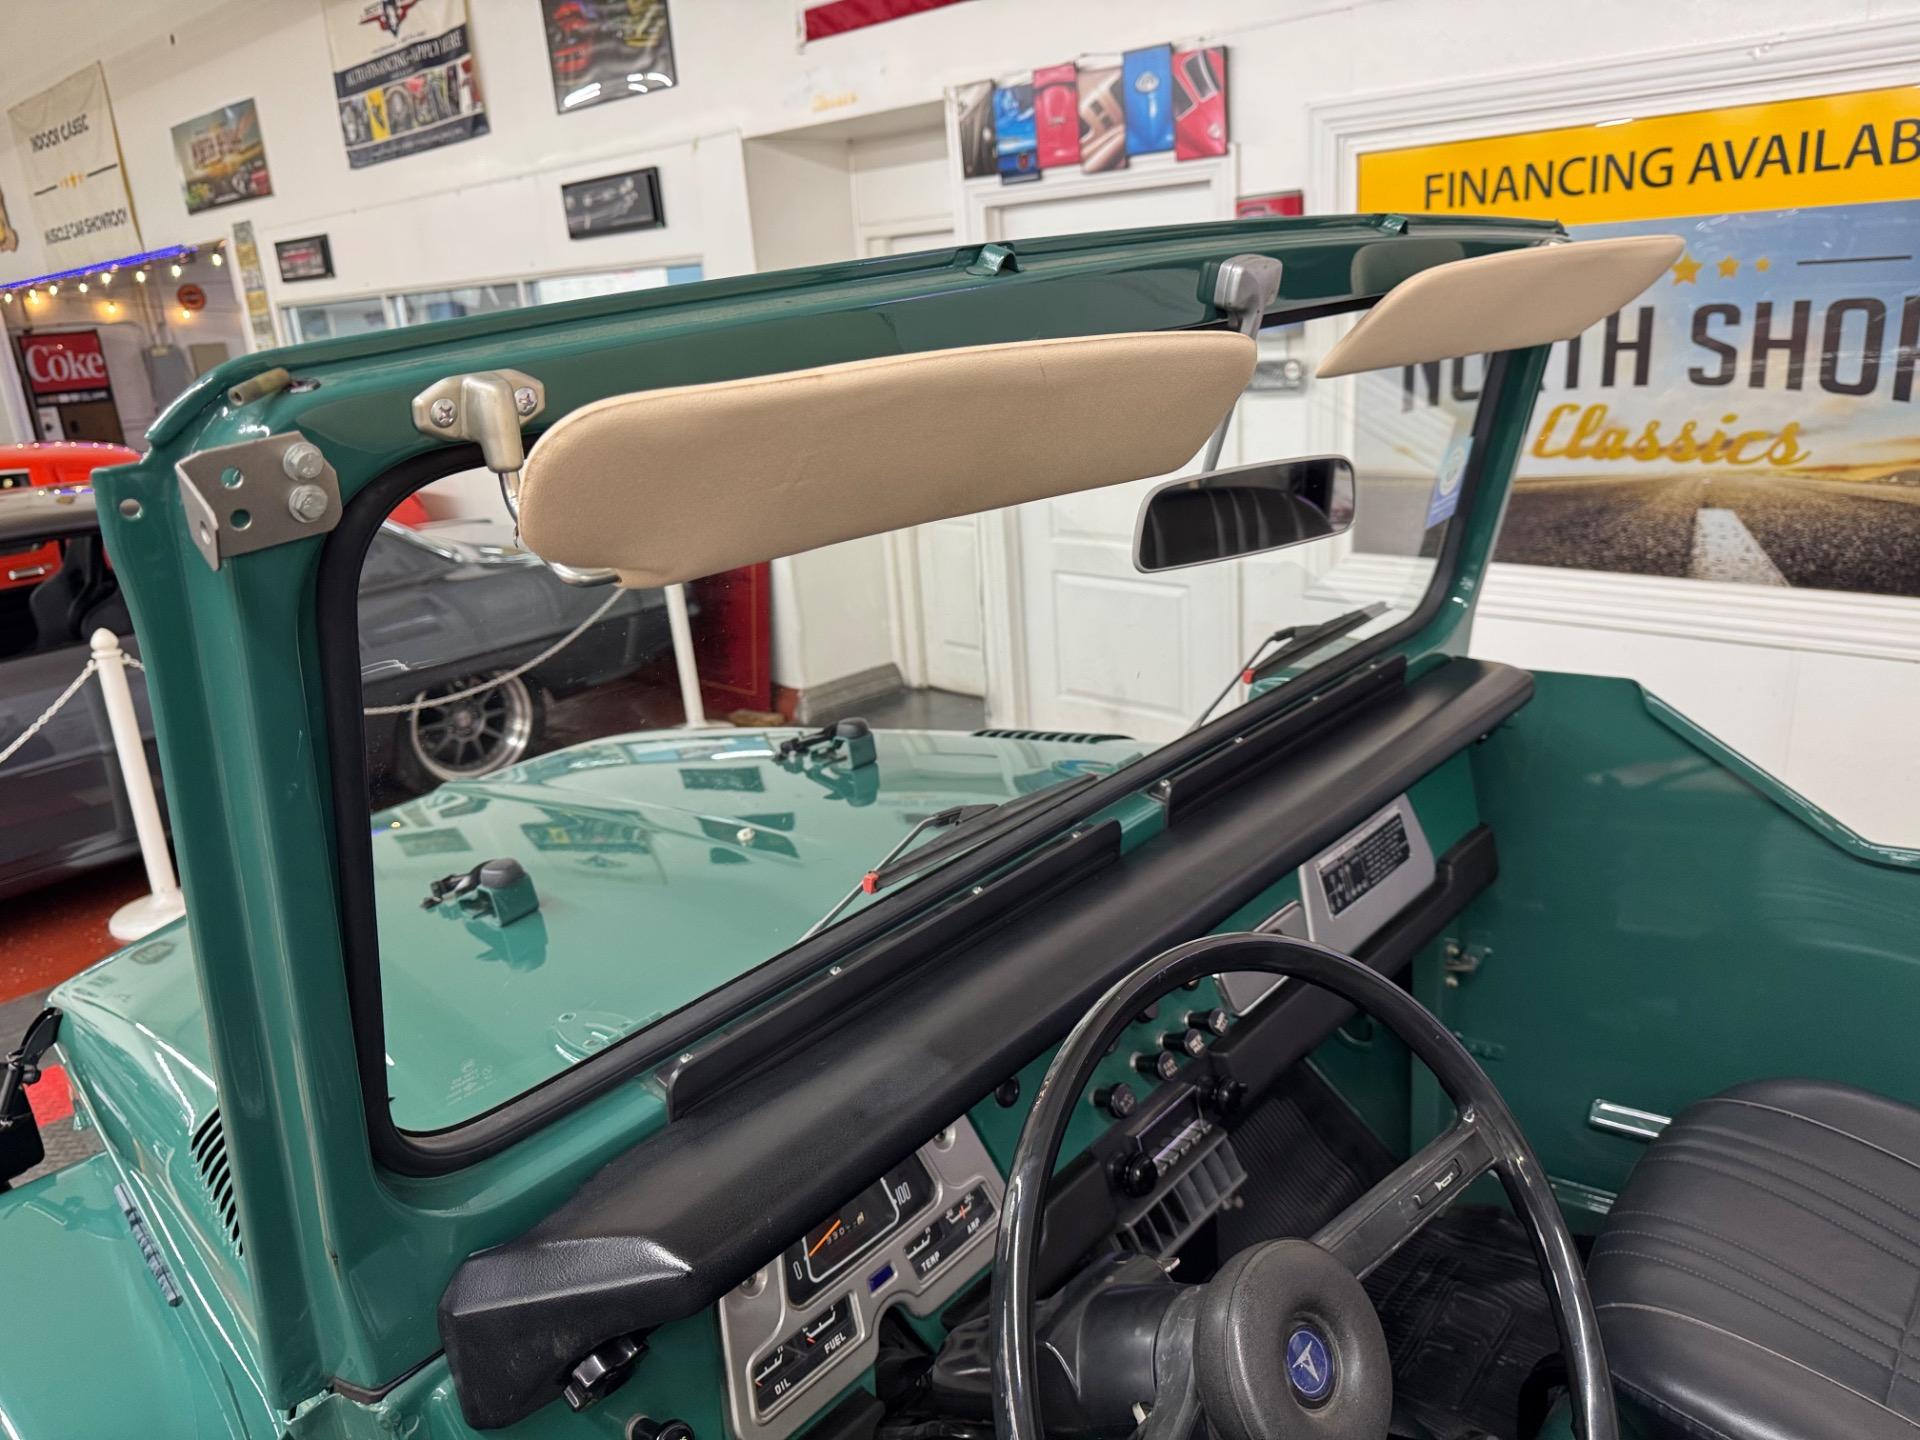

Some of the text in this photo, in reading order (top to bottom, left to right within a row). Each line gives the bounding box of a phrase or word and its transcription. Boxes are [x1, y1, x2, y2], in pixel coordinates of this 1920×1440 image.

[1425, 147, 1674, 210] FINANCING
[26, 345, 106, 382] Coke
[1532, 402, 1813, 465] Classics
[895, 1182, 912, 1206] 100
[967, 1217, 980, 1234] AMP
[921, 1251, 940, 1272] TEMP
[824, 1332, 846, 1354] FUEL
[774, 1378, 791, 1395] OIL
